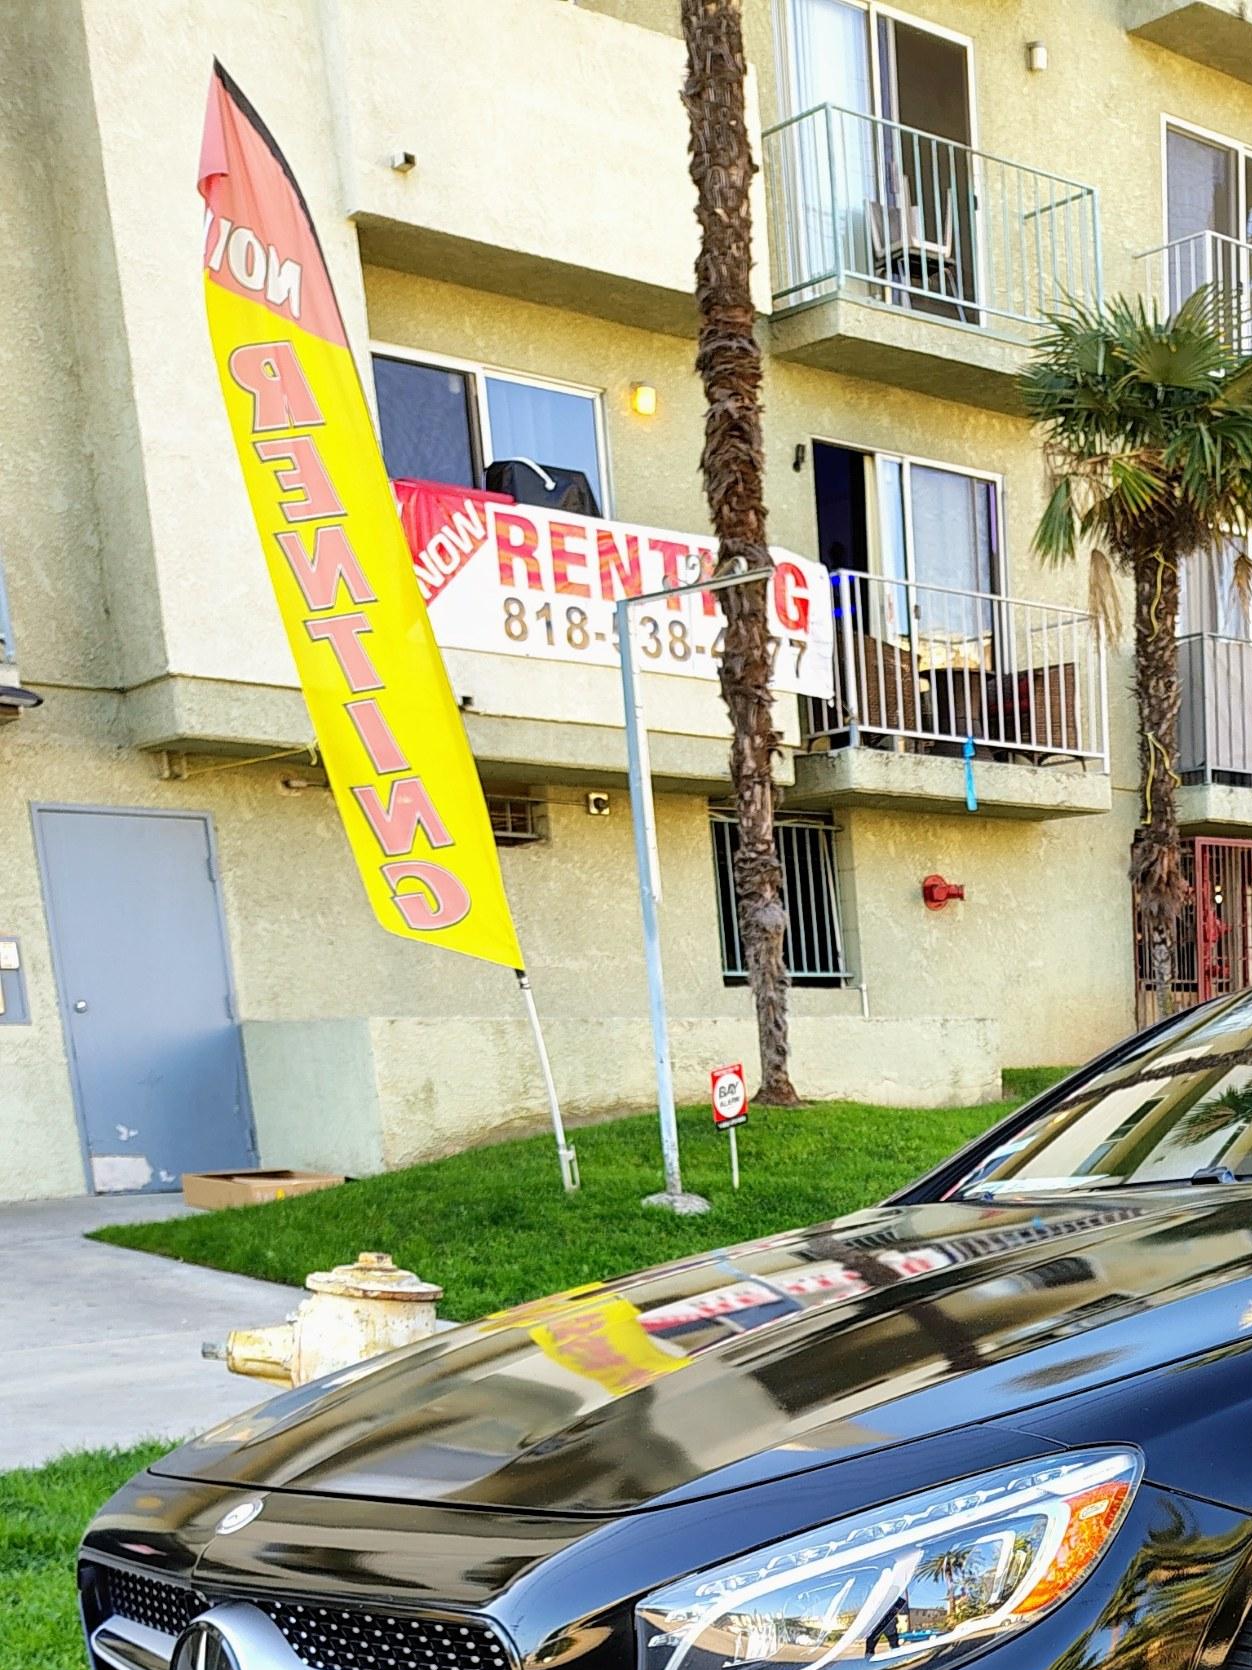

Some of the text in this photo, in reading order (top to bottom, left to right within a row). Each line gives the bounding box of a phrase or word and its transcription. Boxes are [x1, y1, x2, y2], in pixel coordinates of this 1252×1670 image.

[413, 498, 486, 600] NOW
[495, 511, 810, 634] RENTIG
[503, 597, 807, 679] 818-38-77
